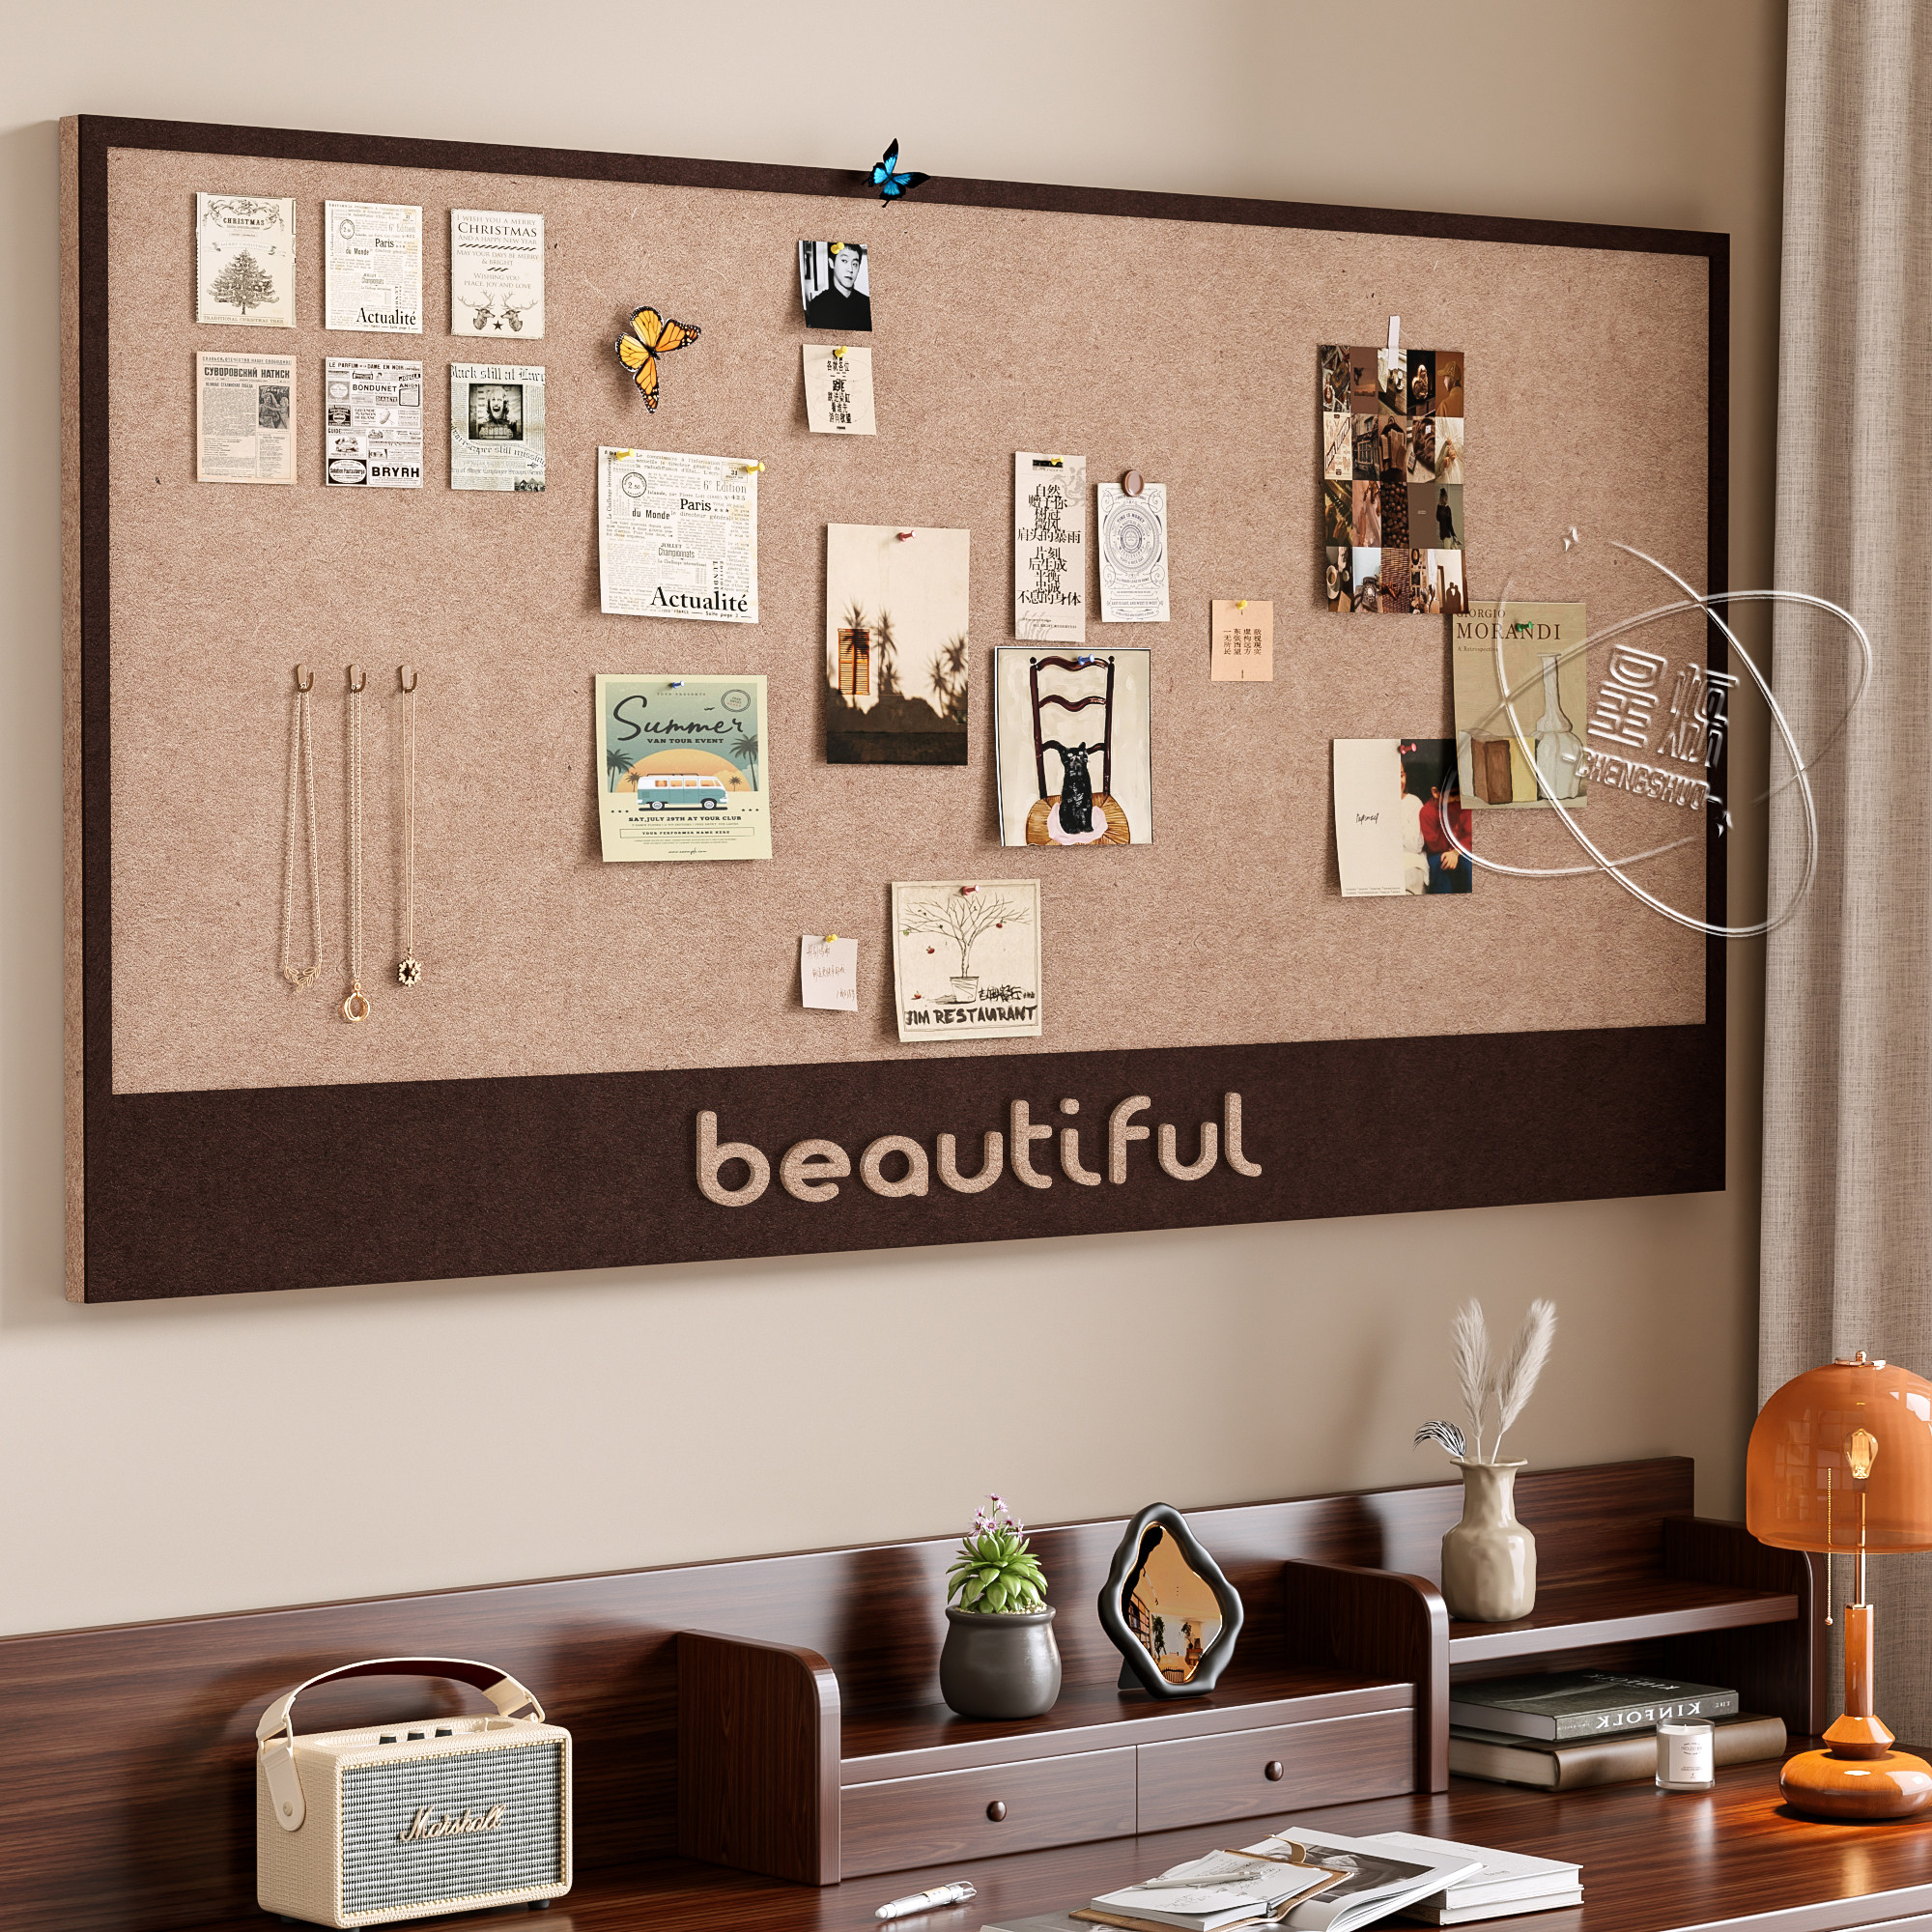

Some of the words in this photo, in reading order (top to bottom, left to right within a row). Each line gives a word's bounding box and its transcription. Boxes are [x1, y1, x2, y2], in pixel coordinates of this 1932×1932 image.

[458, 222, 537, 237] CHRISTMAS
[375, 238, 395, 248] Paris
[356, 307, 416, 325] Actualité
[204, 367, 257, 378] СУВОРОВСКИЙ
[261, 369, 289, 378] НАТИСК
[481, 367, 502, 380] still
[353, 384, 397, 392] BONDUNET
[372, 467, 420, 478] BRYRH
[716, 482, 747, 494] Edition
[1037, 483, 1060, 497] 自然
[680, 498, 711, 511] Paris
[632, 508, 641, 517] du
[646, 510, 670, 520] Monde
[1017, 527, 1081, 543] 肩头的暴雨
[659, 548, 695, 558] Championnats
[1036, 546, 1060, 560] 片刻
[1035, 569, 1061, 583] 平衡
[650, 586, 748, 612] Actualité
[1017, 590, 1081, 606] 不息的身体
[1456, 623, 1561, 640] MORANDI
[613, 695, 744, 741] Summer
[905, 1009, 930, 1025] JIM
[933, 1005, 1038, 1025] RESTAURANT
[696, 1091, 1262, 1207] beautiful
[399, 1804, 506, 1842] Marshall
